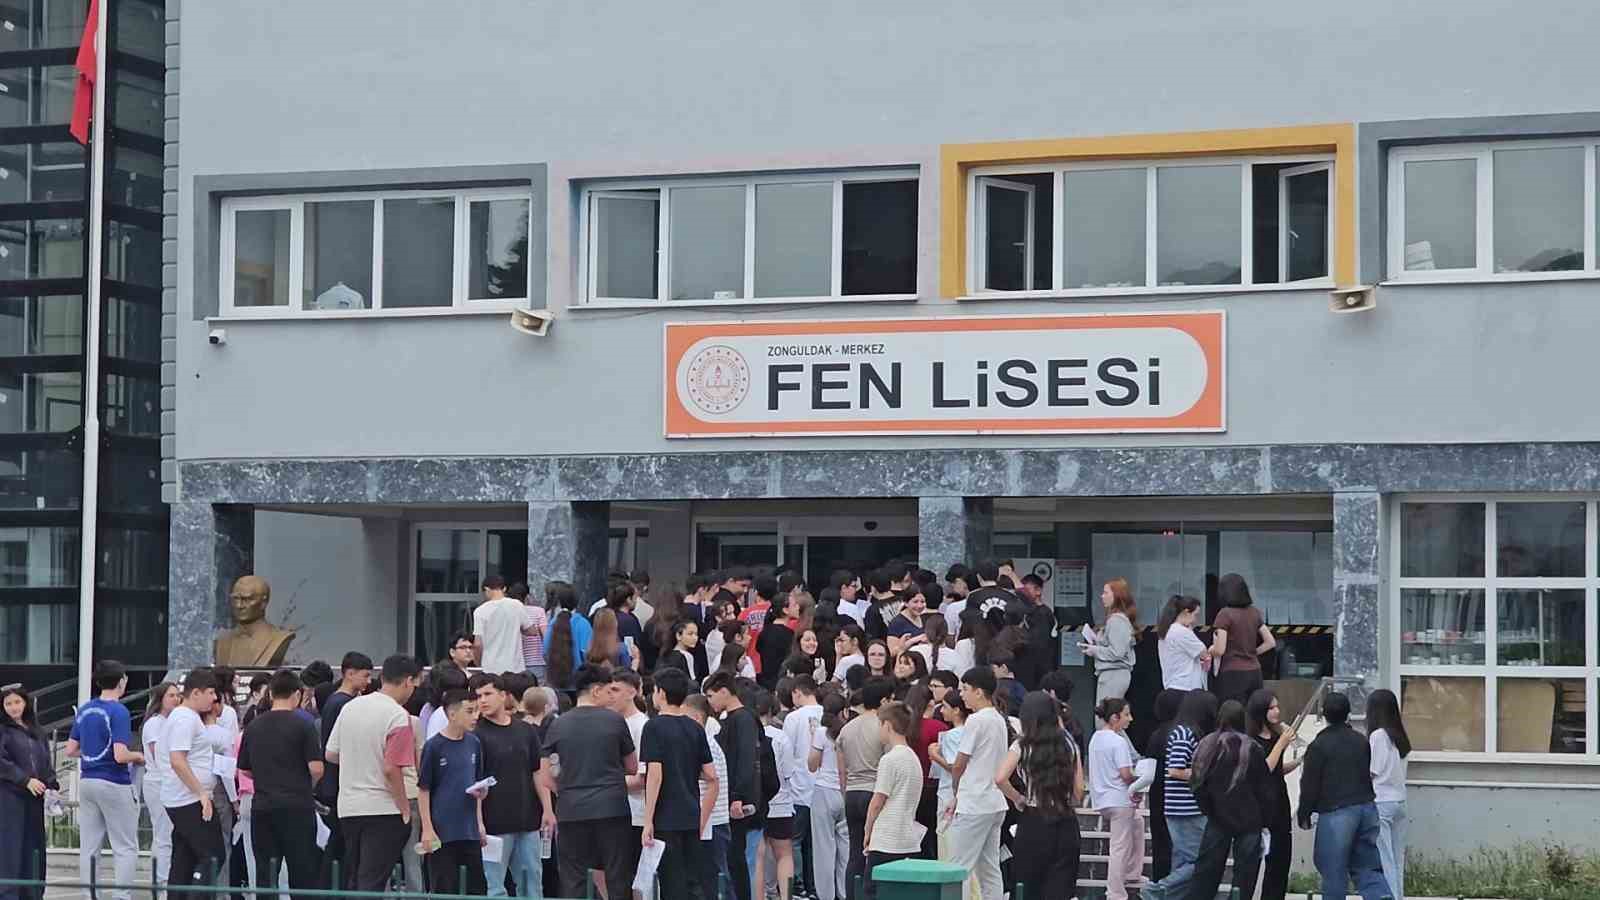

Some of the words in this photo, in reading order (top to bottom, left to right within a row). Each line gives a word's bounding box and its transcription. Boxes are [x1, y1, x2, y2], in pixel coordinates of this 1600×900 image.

[767, 345, 832, 357] ZONGULDAK
[841, 344, 885, 355] MERKEZ
[767, 362, 902, 411] FEN
